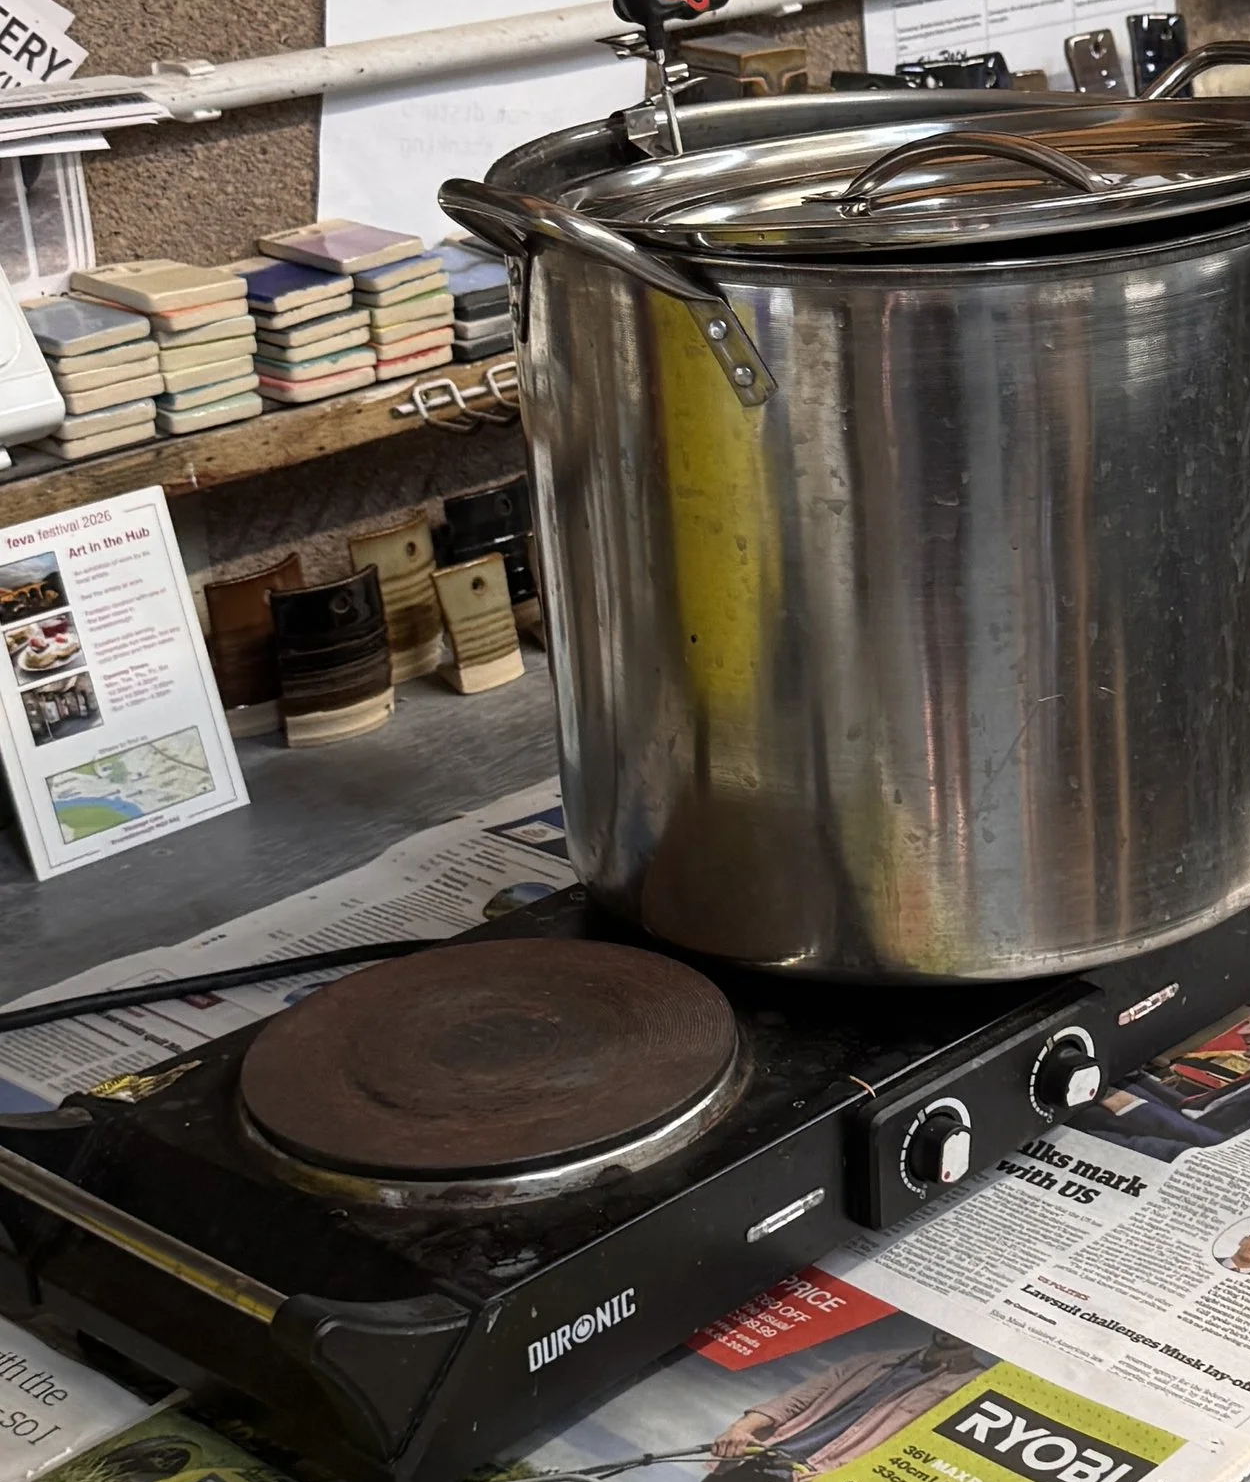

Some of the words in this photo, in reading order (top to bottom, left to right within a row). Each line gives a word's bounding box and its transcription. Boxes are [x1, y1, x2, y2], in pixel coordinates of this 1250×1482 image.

[38, 519, 81, 542] festival
[82, 510, 113, 530] 2026
[69, 545, 88, 560] Art
[89, 541, 103, 554] in
[103, 535, 124, 551] the
[124, 527, 151, 544] Hub
[996, 1159, 1058, 1190] with
[1057, 1180, 1102, 1205] US
[1069, 1159, 1149, 1199] mark
[781, 1276, 847, 1313] PRICE
[1048, 1280, 1091, 1301] POLITICS
[527, 1287, 636, 1373] DURONIC
[758, 1311, 796, 1332] usual
[780, 1305, 811, 1324] OFF
[1021, 1283, 1083, 1317] Lawsuit
[1079, 1310, 1161, 1351] challenges
[1158, 1342, 1205, 1373] Musk
[18, 1371, 69, 1407] the
[28, 1424, 62, 1445] I
[888, 1455, 930, 1482] 40cm
[902, 1444, 937, 1465] 36V
